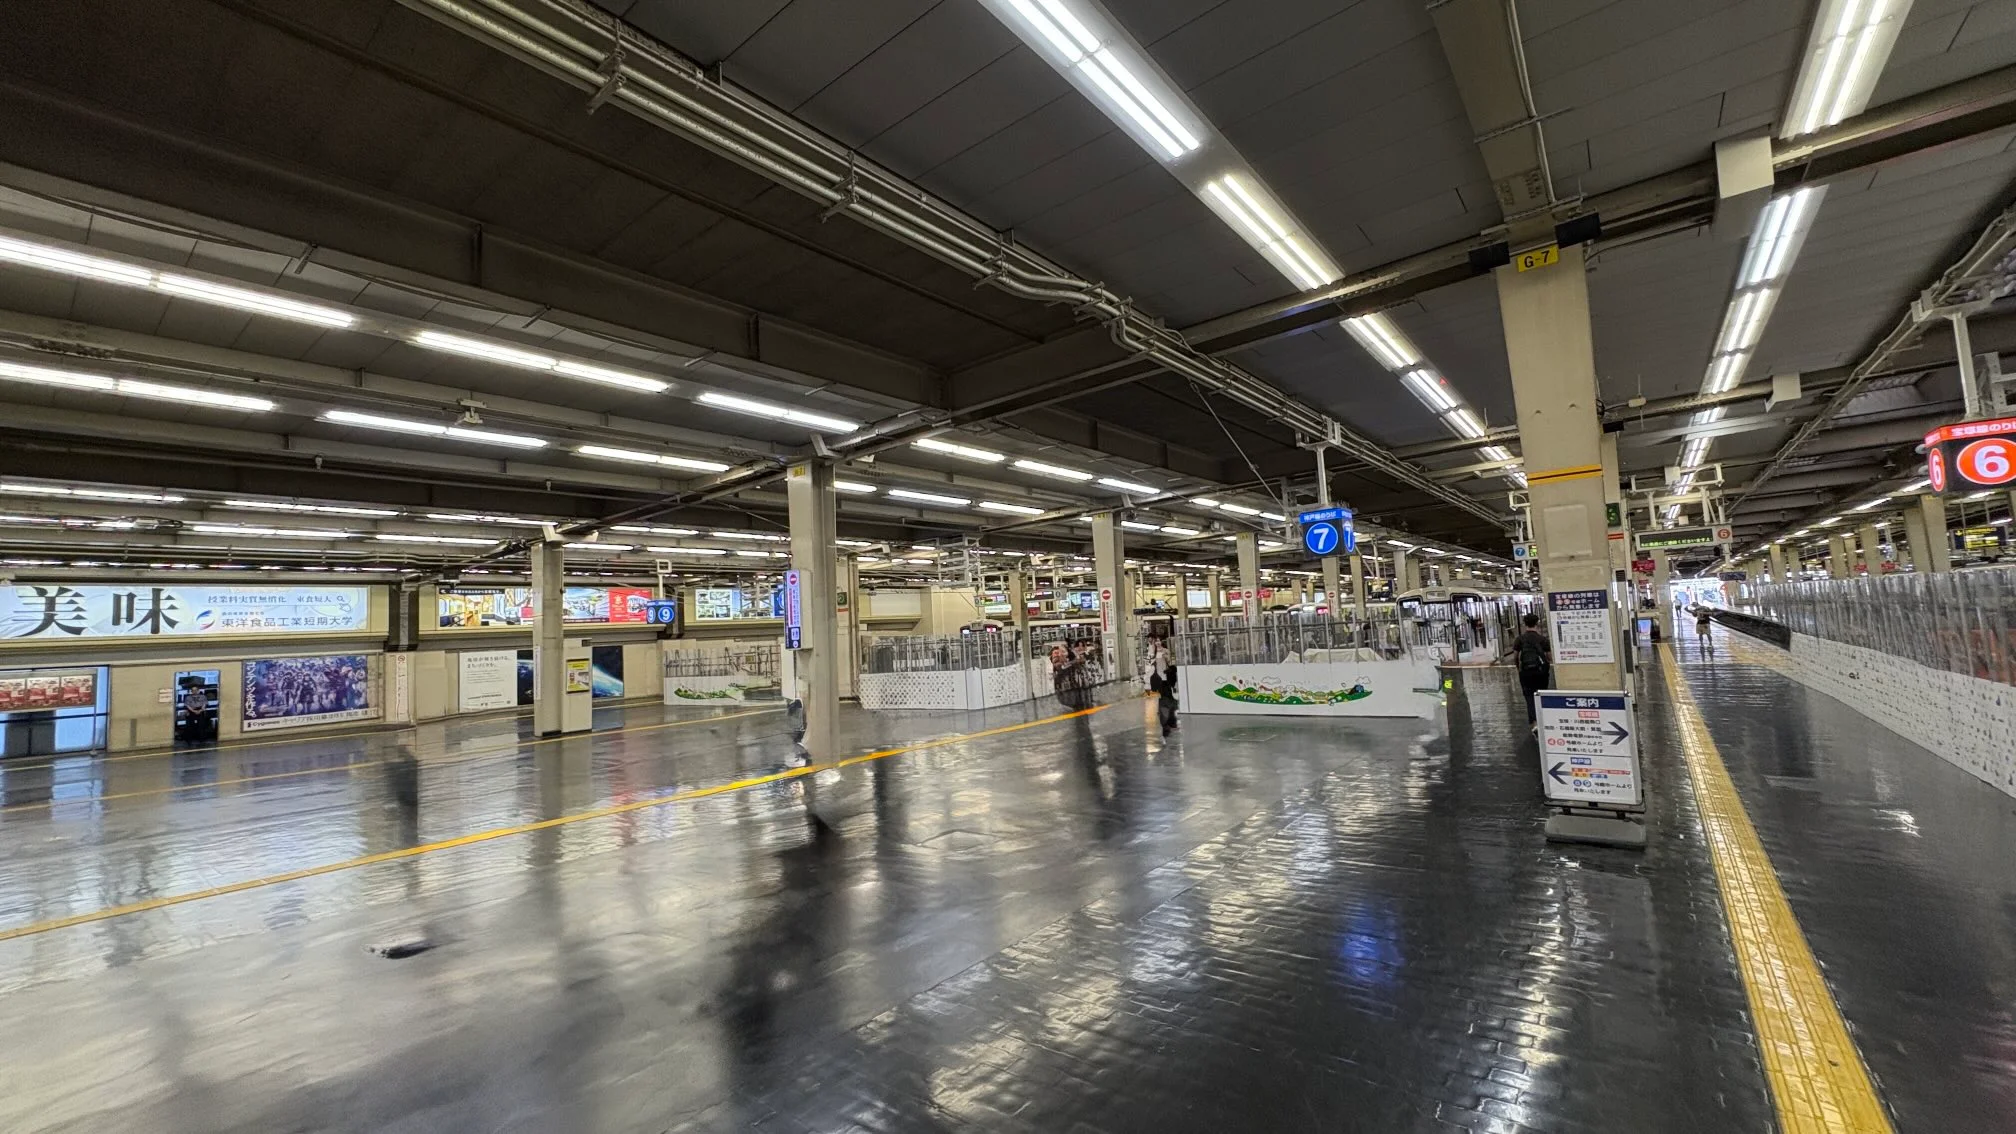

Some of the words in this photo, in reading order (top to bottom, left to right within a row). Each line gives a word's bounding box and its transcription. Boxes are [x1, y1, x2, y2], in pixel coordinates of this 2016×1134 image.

[1524, 250, 1549, 268] G-7
[1932, 455, 1941, 485] 6
[1974, 445, 2010, 478] 6
[1313, 528, 1329, 550] 7
[221, 616, 353, 628] 東洋食品工業短期大学
[662, 608, 671, 621] 9
[1566, 698, 1599, 707] ご案内
